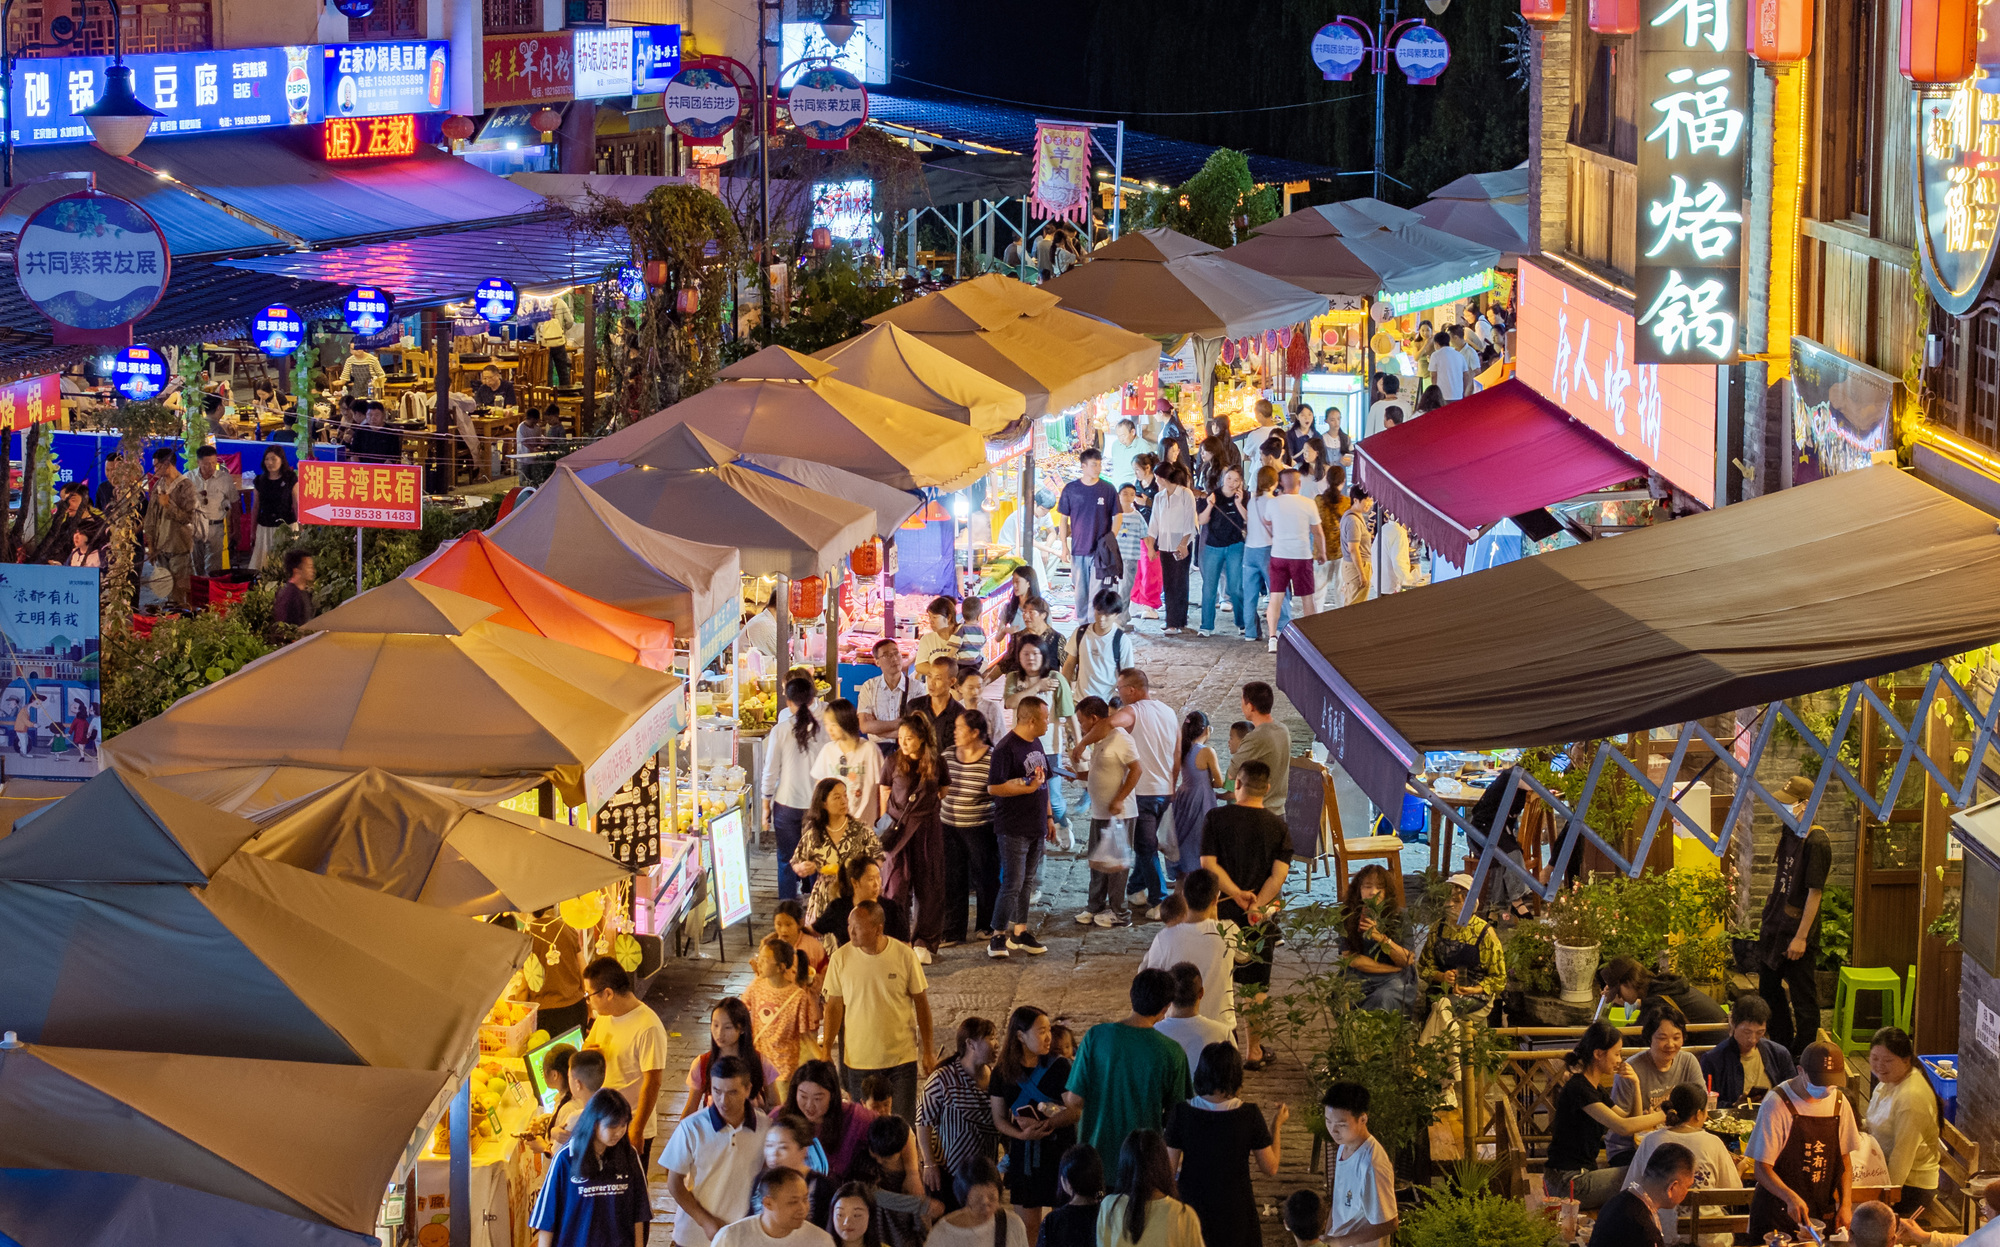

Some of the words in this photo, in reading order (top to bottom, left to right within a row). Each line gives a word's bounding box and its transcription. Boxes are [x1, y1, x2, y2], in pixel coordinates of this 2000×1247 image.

[1314, 43, 1361, 55] 共同团结进步
[1399, 48, 1446, 59] 共同繁荣发展
[339, 45, 427, 73] 左家砂锅臭豆腐
[25, 64, 218, 117] 砂锅豆腐
[287, 84, 309, 93] PEPSI
[668, 96, 735, 110] 共同团结进步
[793, 98, 861, 113] 共同繁荣发展
[25, 250, 158, 276] 共同繁荣发展
[348, 301, 386, 313] 思源烙锅
[257, 320, 300, 333] 思源烙锅
[117, 361, 162, 375] 思源烙锅
[303, 464, 415, 503] 湖景湾民宿
[331, 508, 352, 517] 139
[354, 510, 382, 519] 8538
[385, 511, 412, 521] 1483
[14, 610, 79, 628] 文明有我
